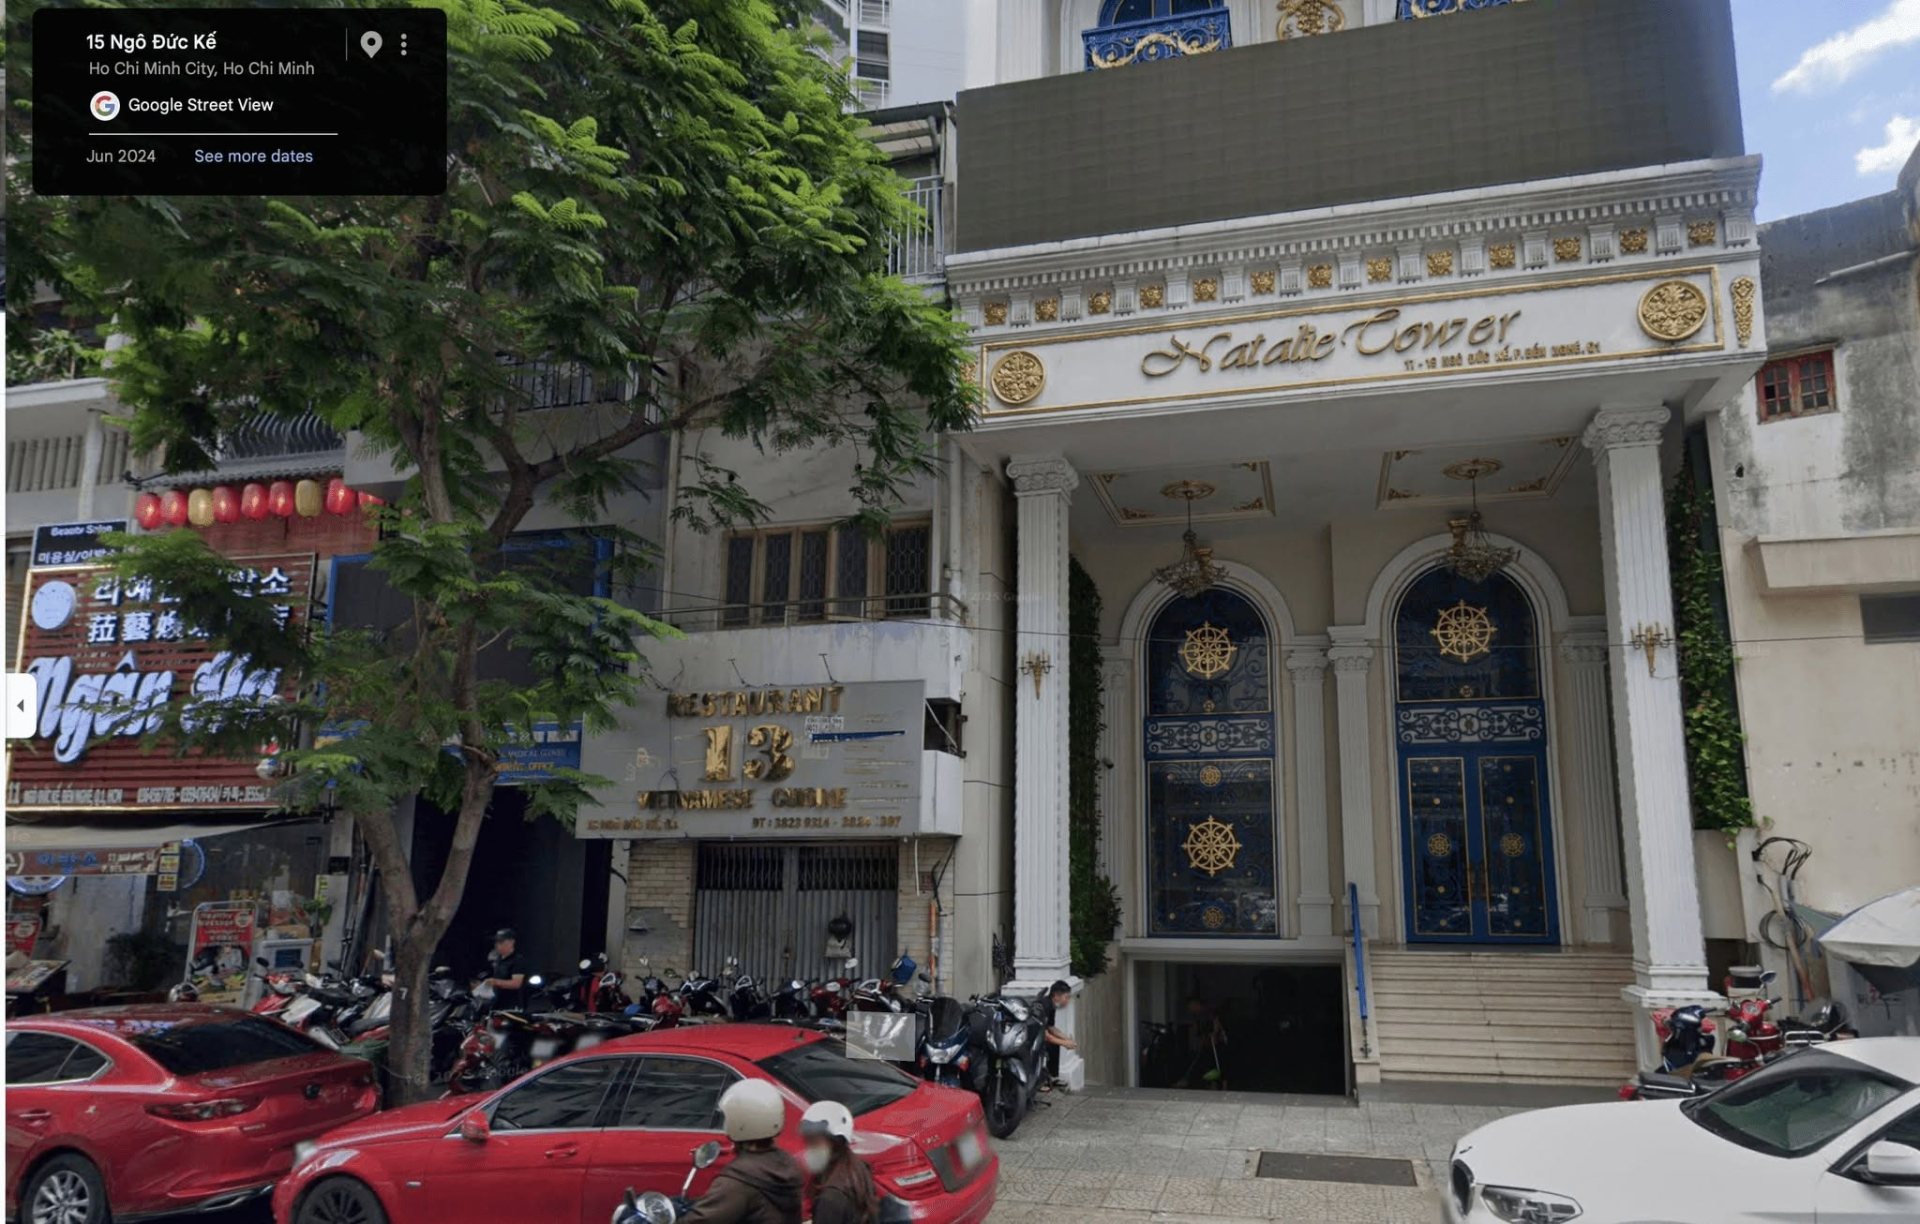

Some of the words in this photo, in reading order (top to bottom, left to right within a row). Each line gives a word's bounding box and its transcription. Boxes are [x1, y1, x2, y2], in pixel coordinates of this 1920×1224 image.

[1141, 322, 1336, 377] Natalie
[1342, 308, 1523, 356] Tower
[665, 685, 845, 718] RESTAURANT
[698, 724, 796, 783] 13
[637, 786, 757, 811] VIETNAMESE
